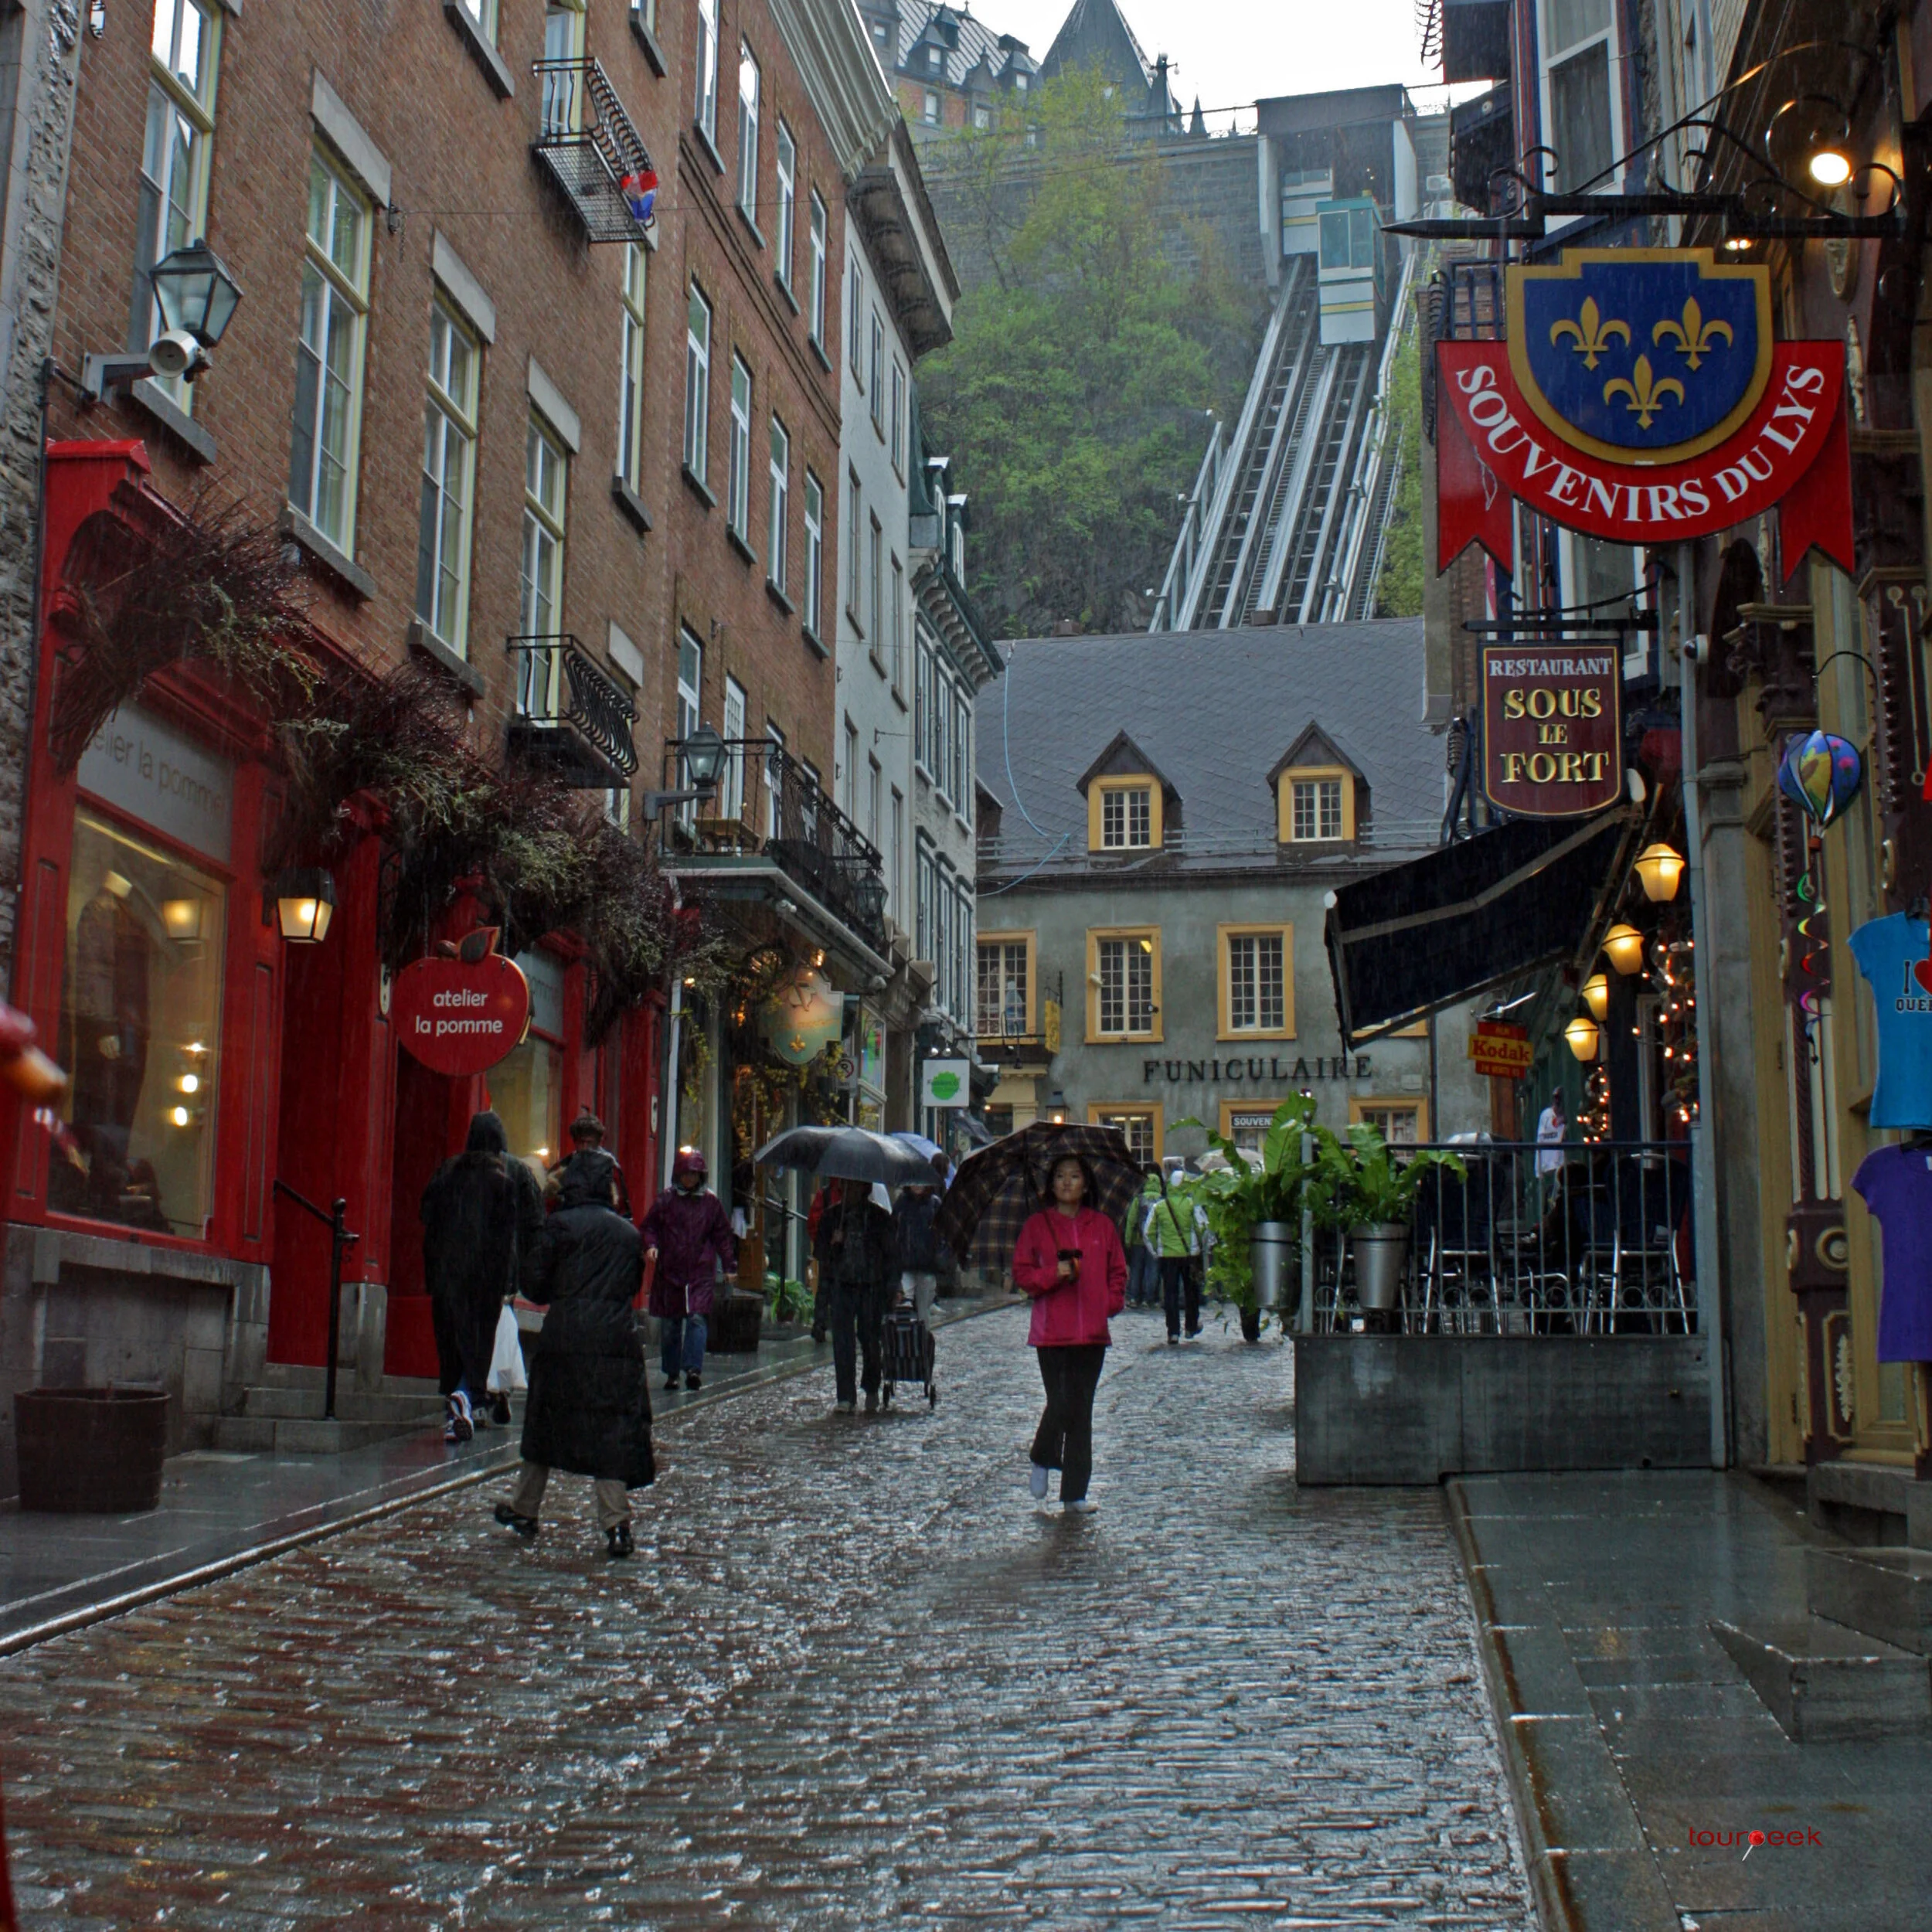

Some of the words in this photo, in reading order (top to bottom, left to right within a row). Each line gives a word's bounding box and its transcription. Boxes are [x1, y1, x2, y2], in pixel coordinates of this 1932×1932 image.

[1456, 365, 1710, 522] SOUVENIRS
[1712, 444, 1774, 502] DU
[1760, 365, 1825, 455] LYS
[1488, 658, 1612, 677] RESTAURANT
[1503, 688, 1602, 720] SOUS
[1538, 723, 1568, 744] LE
[138, 740, 155, 781] la
[1499, 751, 1610, 784] FORT
[1903, 960, 1912, 995] I
[433, 988, 488, 1008] atelier
[415, 1015, 431, 1034] la
[435, 1019, 503, 1037] pomme
[1472, 1039, 1530, 1063] Kodak
[1143, 1056, 1372, 1082] FUNICULAIRE
[1233, 1117, 1273, 1126] SOUVEN
